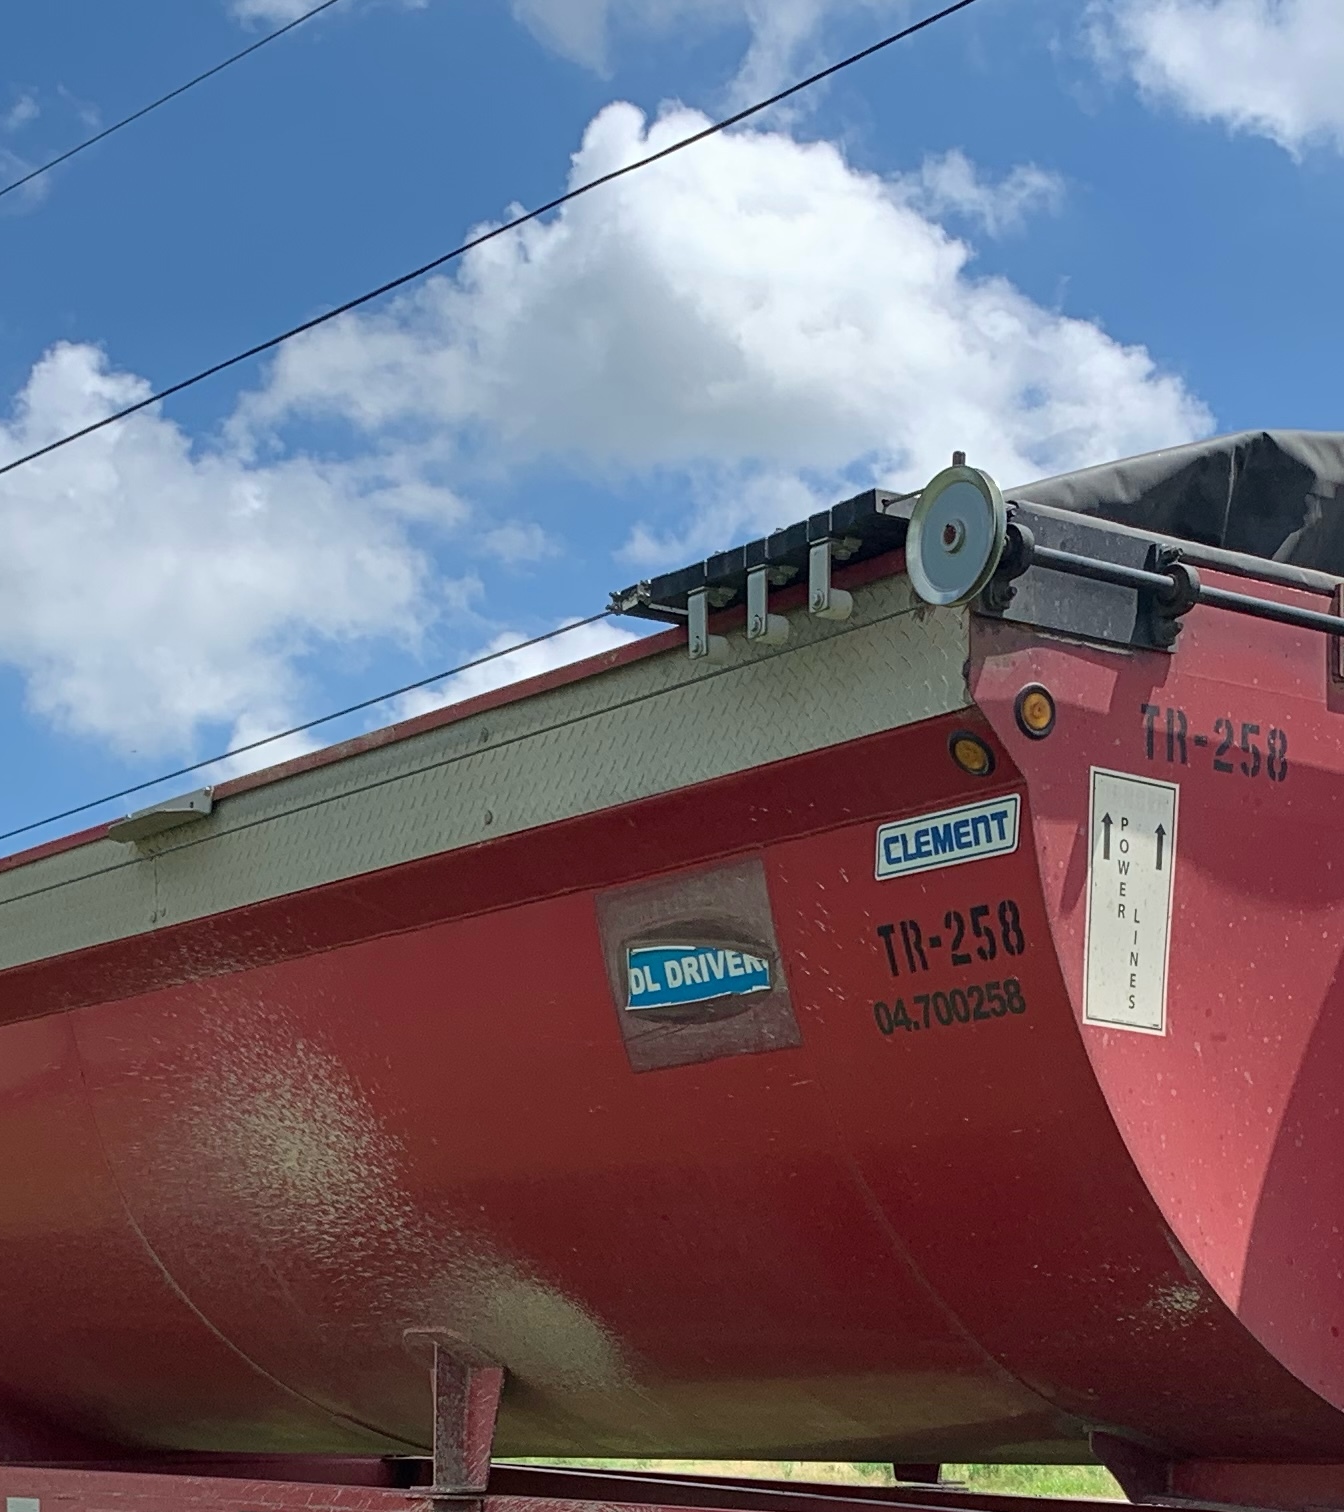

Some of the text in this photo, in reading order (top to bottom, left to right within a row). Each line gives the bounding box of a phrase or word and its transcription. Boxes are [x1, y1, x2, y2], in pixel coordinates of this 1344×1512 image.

[1141, 703, 1288, 783] TR-258
[882, 808, 1010, 866] CLEMENT
[877, 898, 1026, 978] TR-258
[874, 979, 1027, 1036] 04.700258
